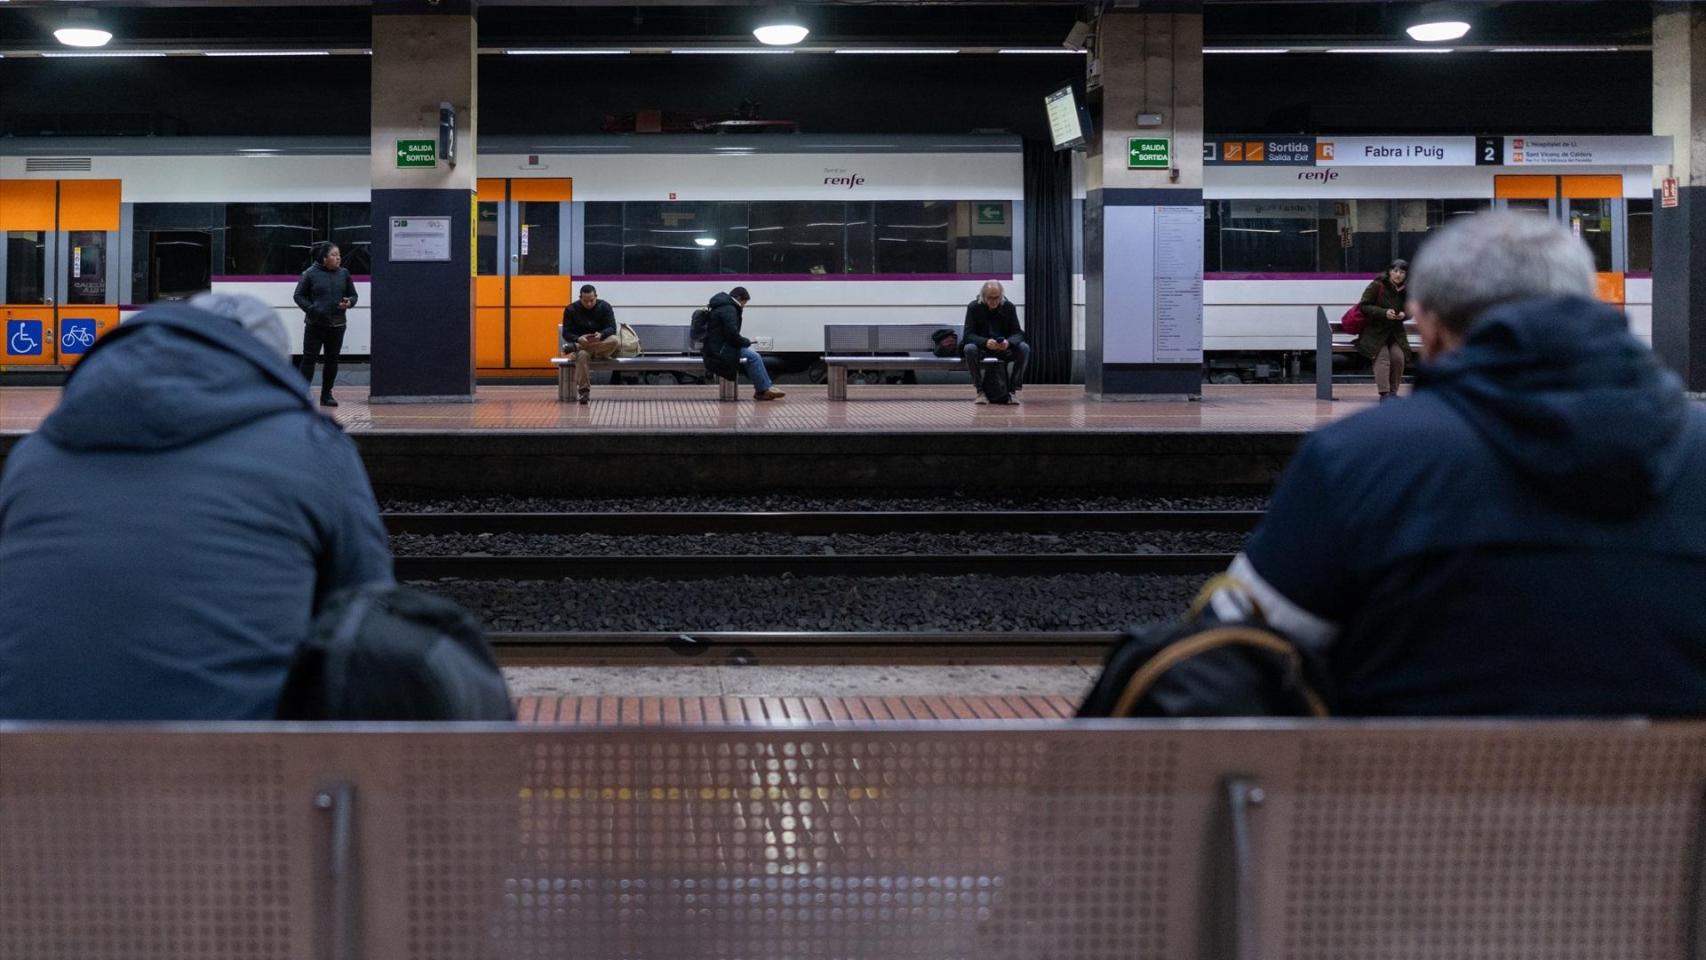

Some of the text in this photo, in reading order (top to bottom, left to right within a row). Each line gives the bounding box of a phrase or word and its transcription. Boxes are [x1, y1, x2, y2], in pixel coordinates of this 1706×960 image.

[1268, 142, 1309, 152] Sortida
[1322, 145, 1333, 157] R
[1365, 145, 1444, 160] Fabra i Puig
[1484, 147, 1495, 161] 2
[824, 173, 865, 190] renfe
[1298, 168, 1339, 184] renfe
